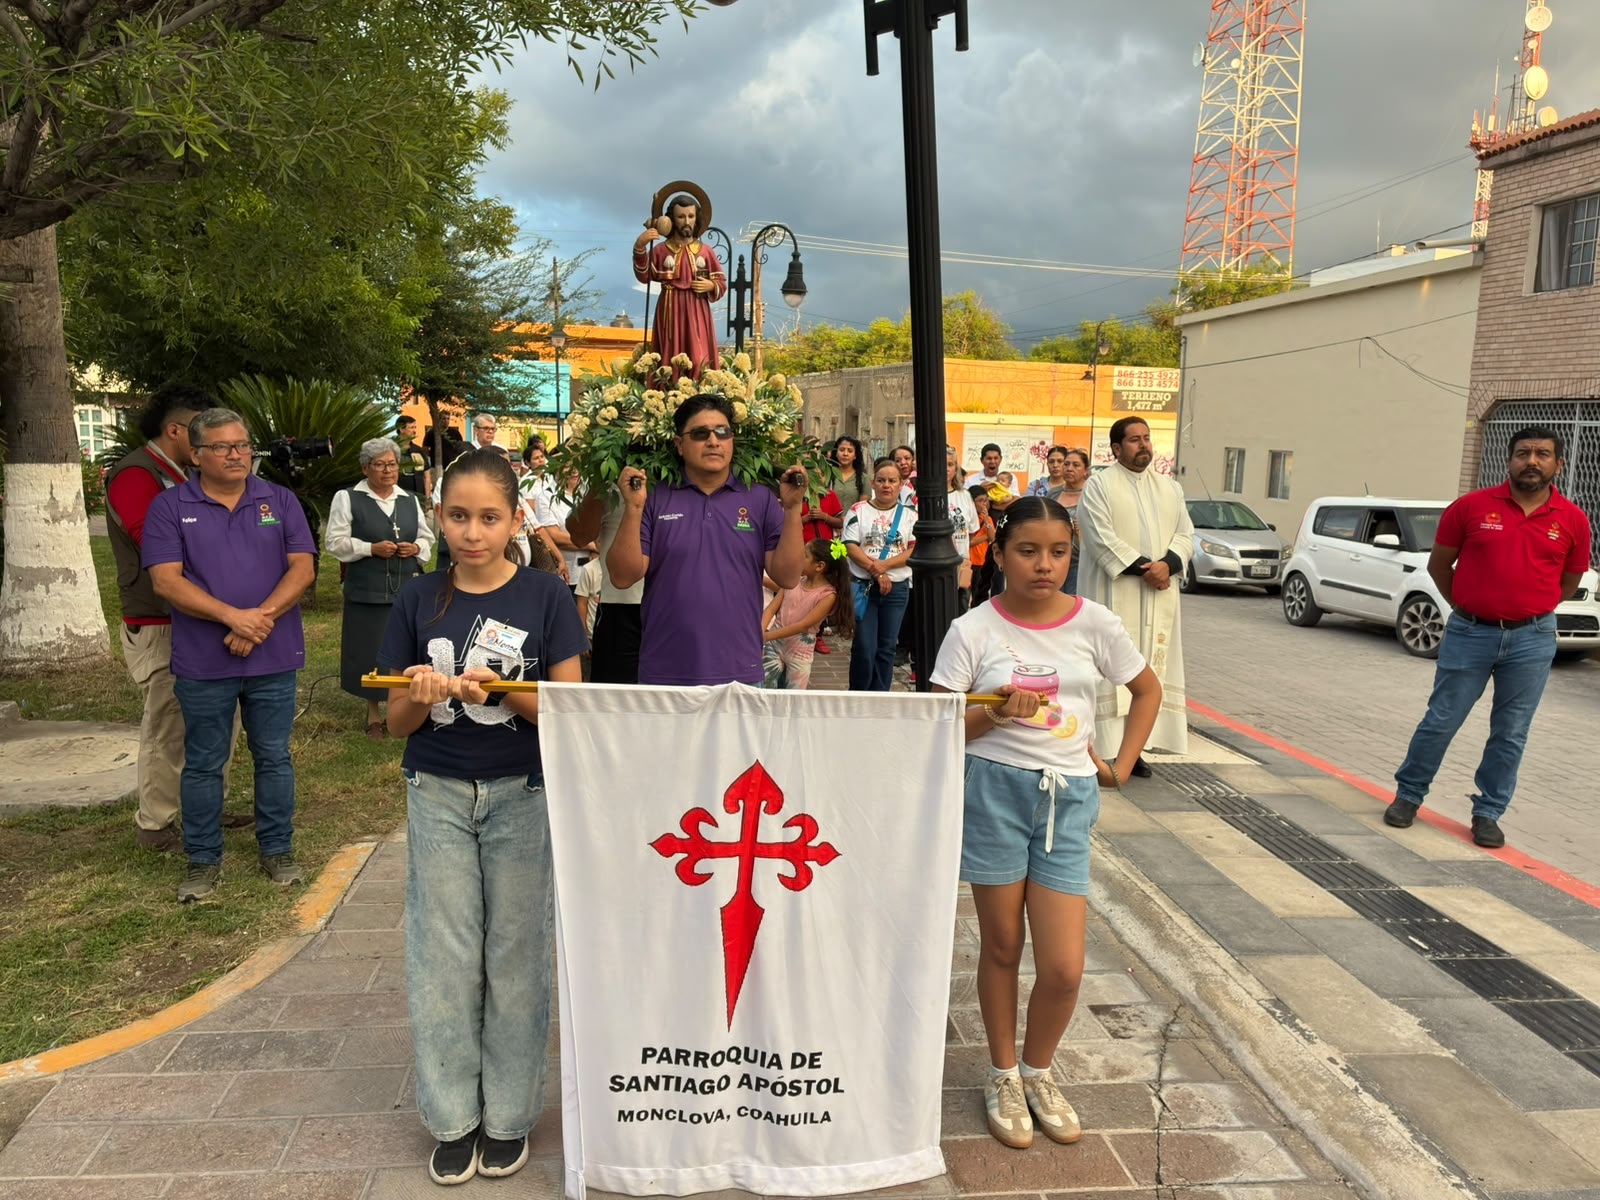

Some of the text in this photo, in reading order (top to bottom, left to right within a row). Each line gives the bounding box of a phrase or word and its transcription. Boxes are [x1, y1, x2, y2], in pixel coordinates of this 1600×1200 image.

[1117, 370, 1135, 378] 866
[1157, 371, 1180, 380] 4922
[1117, 379, 1179, 388] 866 133 4574
[1121, 391, 1172, 401] TERRENO
[1127, 401, 1152, 411] 1,477
[641, 1046, 823, 1070] PARROQUIA DE
[608, 1073, 845, 1098] SANTIAGO APÓSTOL
[617, 1106, 832, 1127] MONCLOVA, COAHUILA
